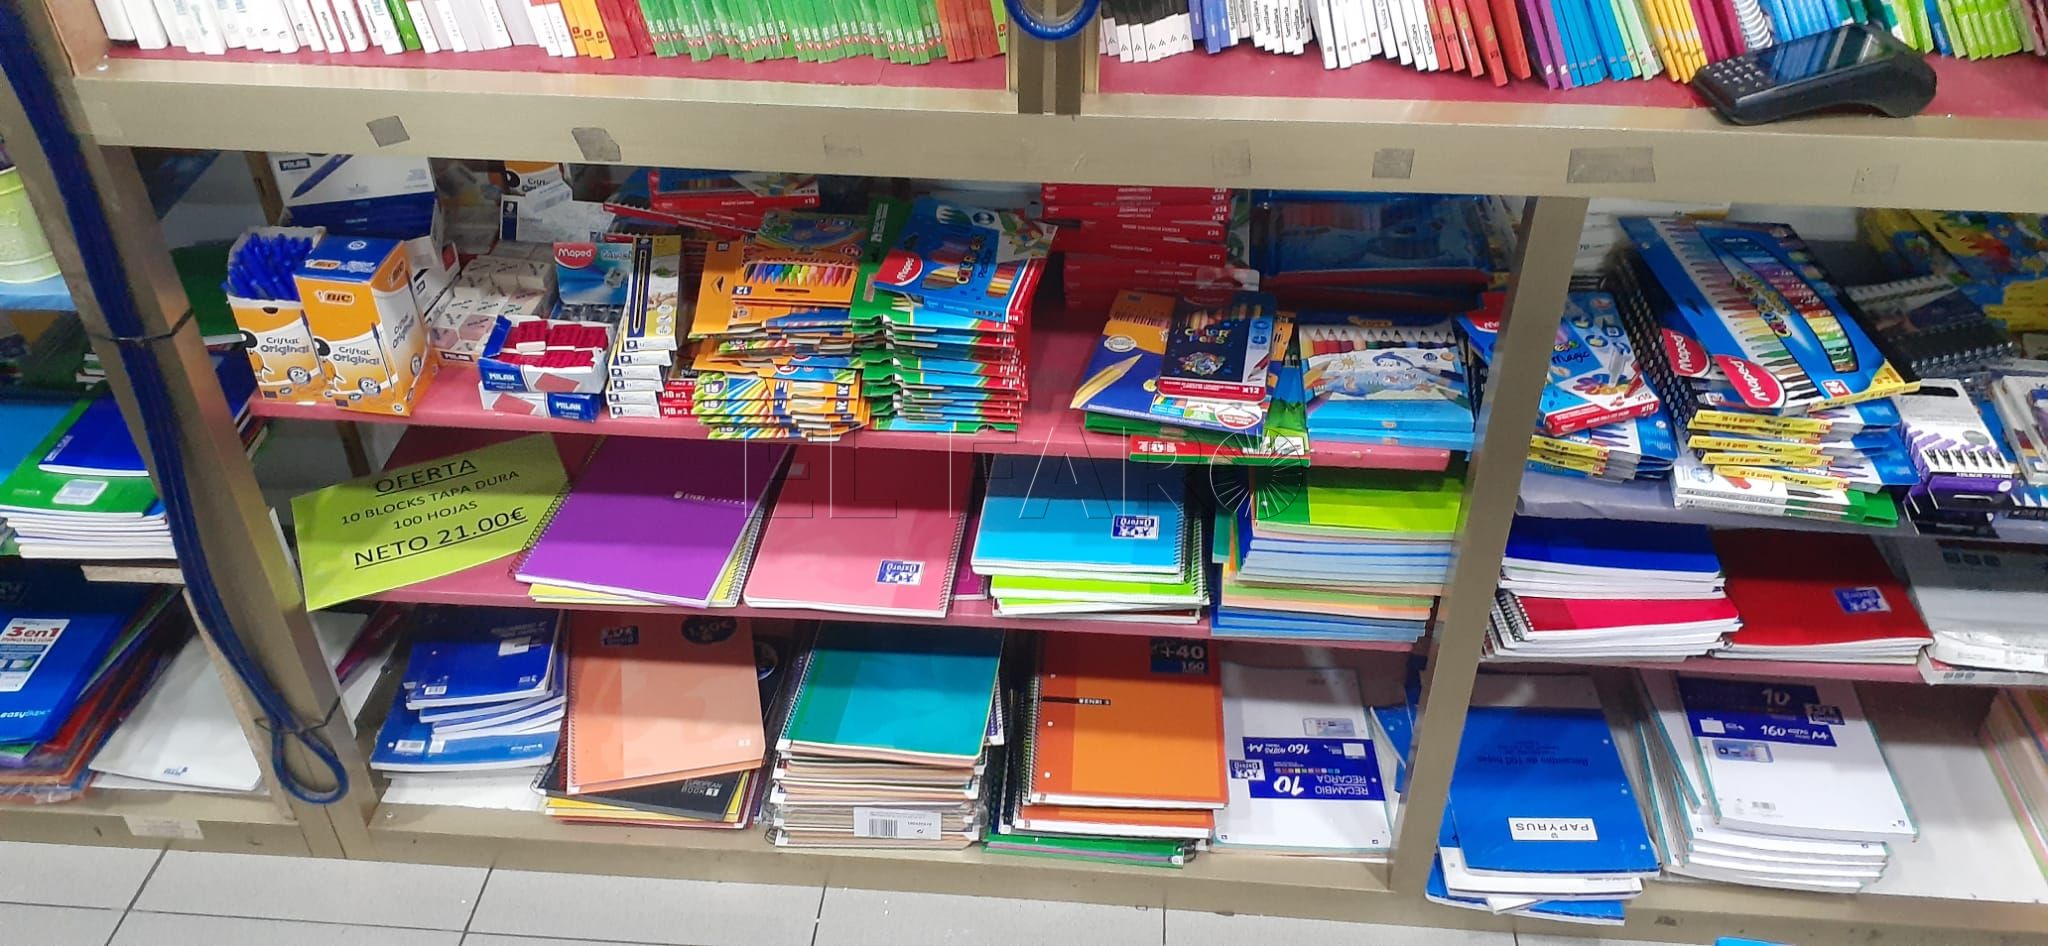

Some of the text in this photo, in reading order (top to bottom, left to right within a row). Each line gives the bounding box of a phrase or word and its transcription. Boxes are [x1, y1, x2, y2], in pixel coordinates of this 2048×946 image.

[558, 248, 593, 259] Maped
[325, 293, 352, 303] BIC
[260, 345, 310, 356] Original
[1670, 334, 1695, 374] Maped
[333, 353, 381, 365] Original
[489, 372, 515, 381] MILAN
[1728, 357, 1770, 403] Maped
[556, 402, 581, 411] MILAN
[375, 459, 477, 494] OFERTA
[341, 471, 520, 525] 10 BLOCKS TAPA DURA
[393, 500, 478, 530] 100 HOJAS
[1120, 516, 1152, 528] Oxford
[354, 506, 528, 566] NETO 21.00€
[886, 561, 917, 574] Oxford
[1760, 687, 1792, 707] 10
[1759, 723, 1787, 737] 160
[1286, 743, 1311, 756] 160
[1316, 774, 1367, 784] RECARGA
[1273, 774, 1305, 798] 10
[1314, 785, 1369, 796] RECAMBIO
[1515, 822, 1589, 832] PAPYRUS
